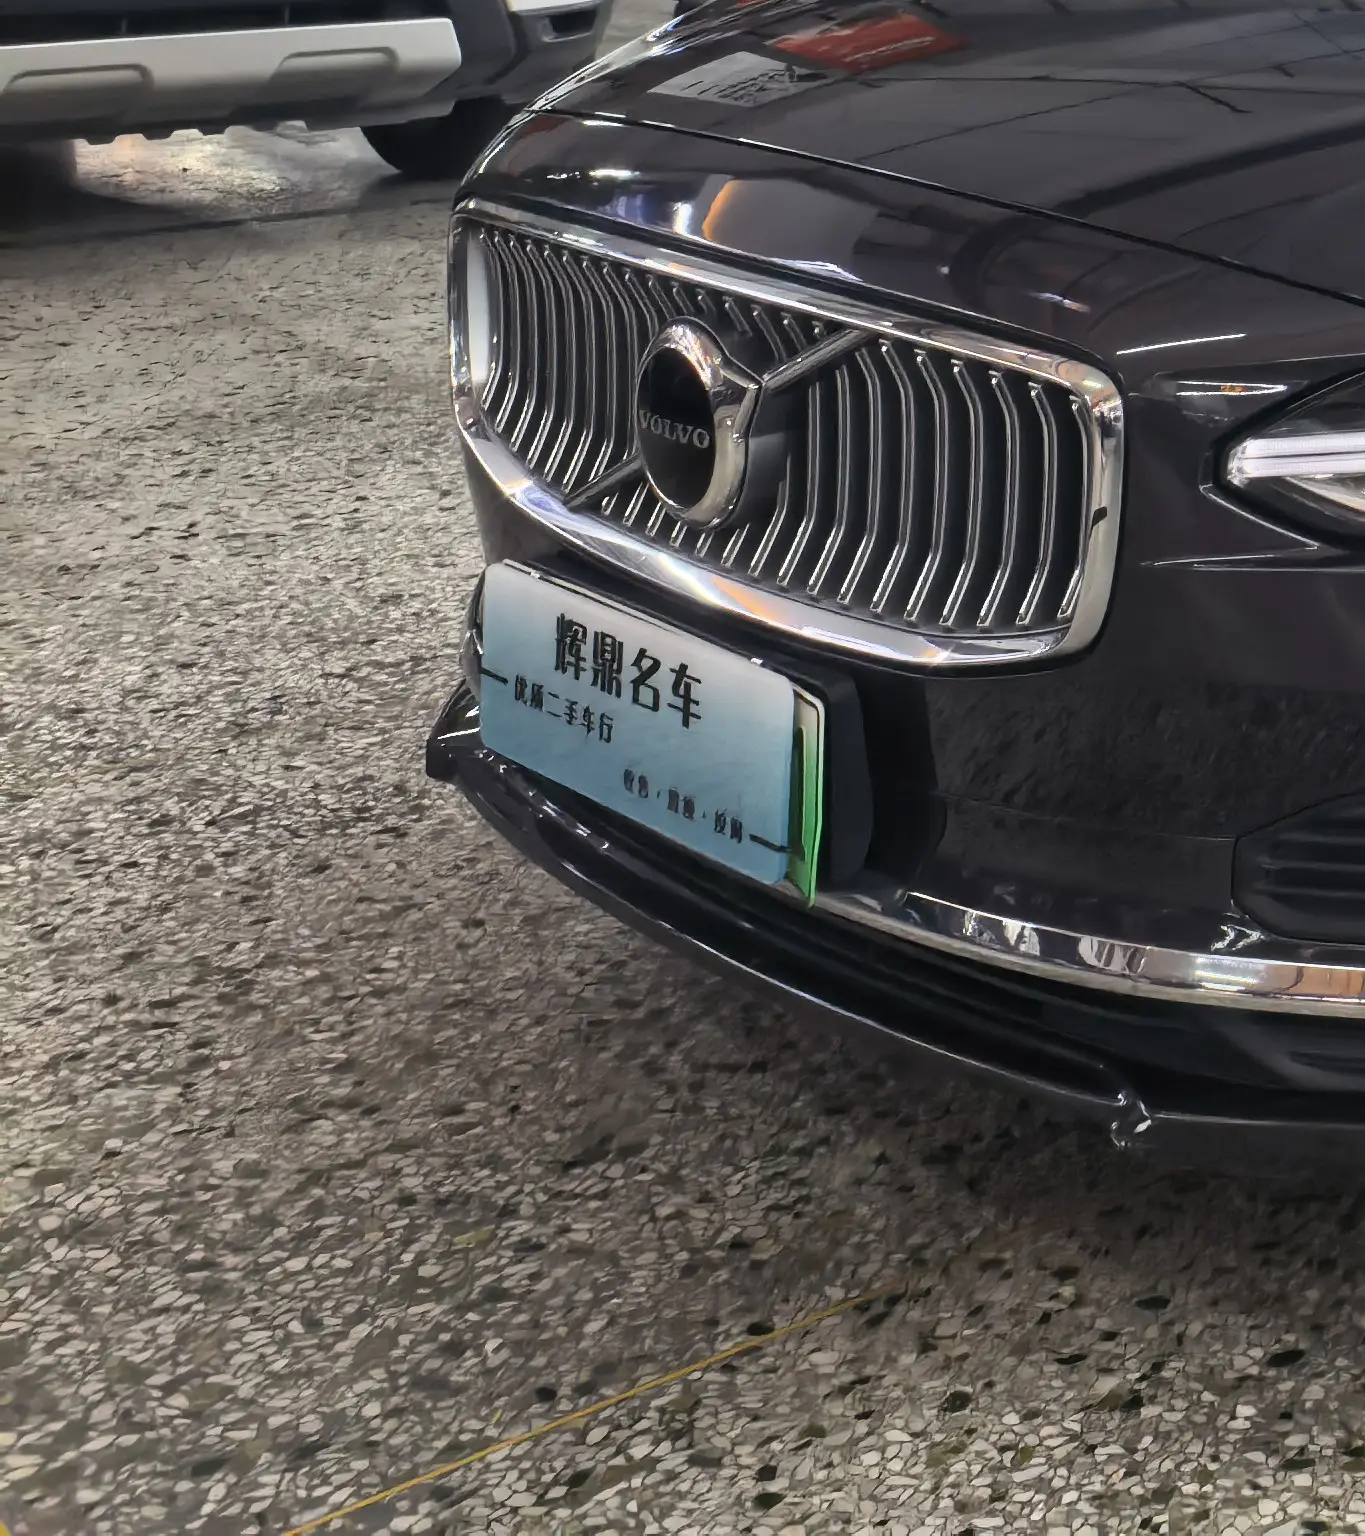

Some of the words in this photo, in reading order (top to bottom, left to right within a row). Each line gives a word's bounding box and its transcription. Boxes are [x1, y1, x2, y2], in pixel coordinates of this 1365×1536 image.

[639, 409, 711, 449] VOLVO
[554, 612, 703, 731] 辉鼎名车
